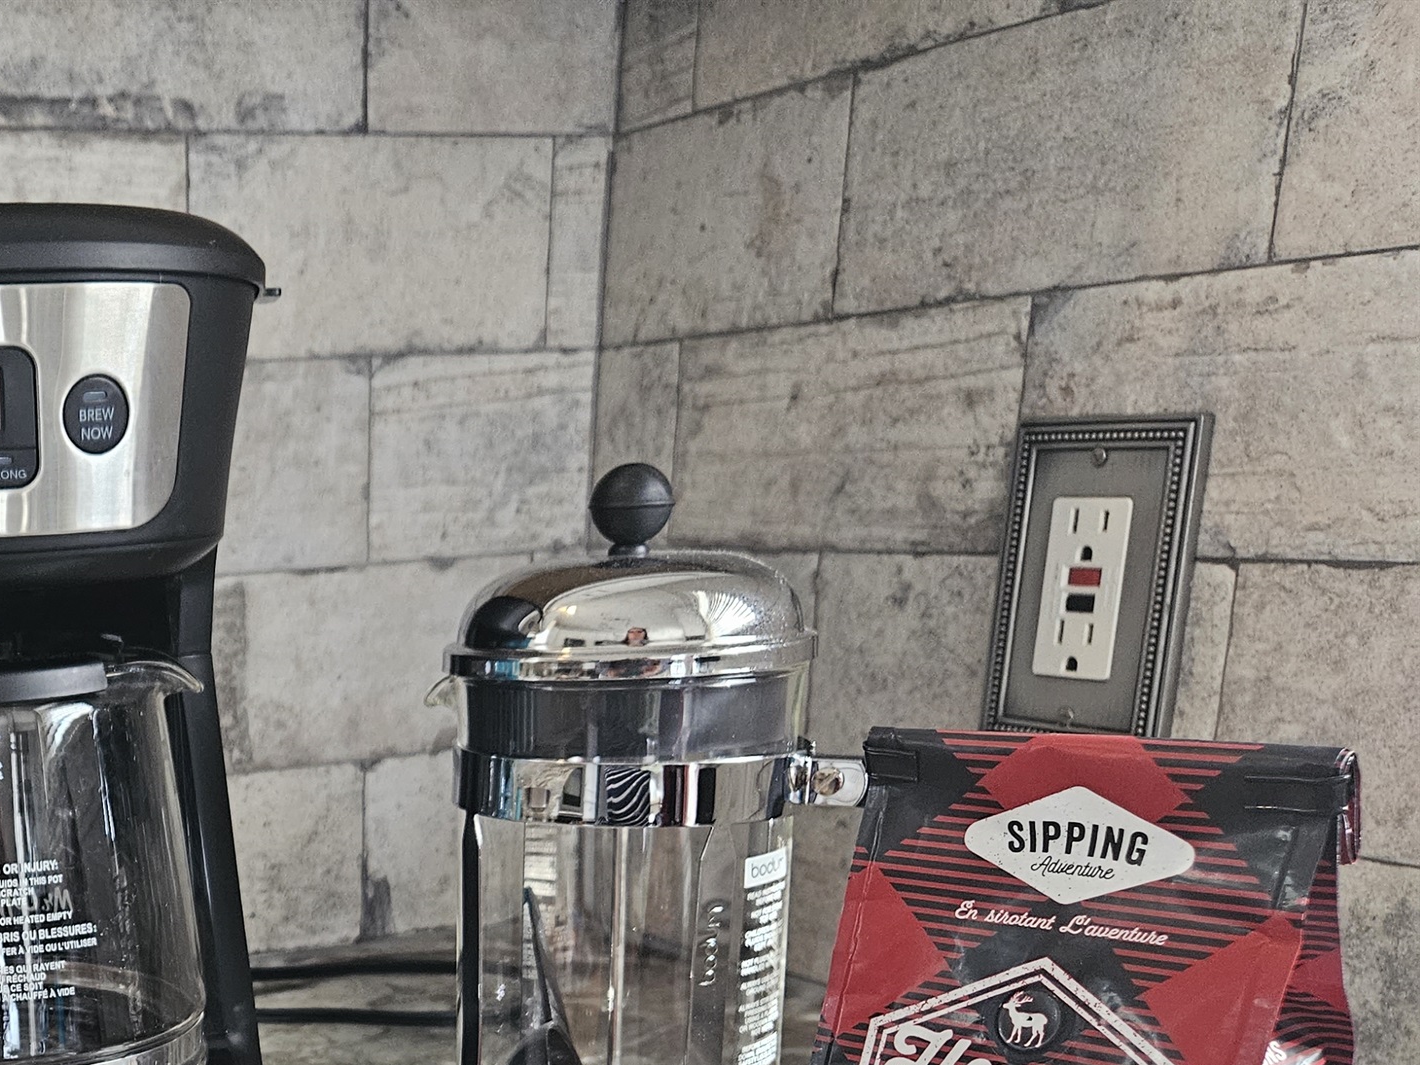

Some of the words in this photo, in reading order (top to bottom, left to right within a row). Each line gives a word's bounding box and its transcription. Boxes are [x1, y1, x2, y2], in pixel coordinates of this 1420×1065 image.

[79, 407, 114, 423] BREW
[81, 426, 113, 440] NOW
[1008, 821, 1148, 866] SIPPING
[3, 863, 18, 874] OR
[1031, 856, 1115, 879] Adventure
[48, 874, 63, 883] POT
[14, 914, 45, 925] HEATED
[47, 910, 72, 922] EMPTY
[955, 900, 977, 920] En
[984, 909, 1057, 930] sirotant
[22, 930, 36, 941] OU
